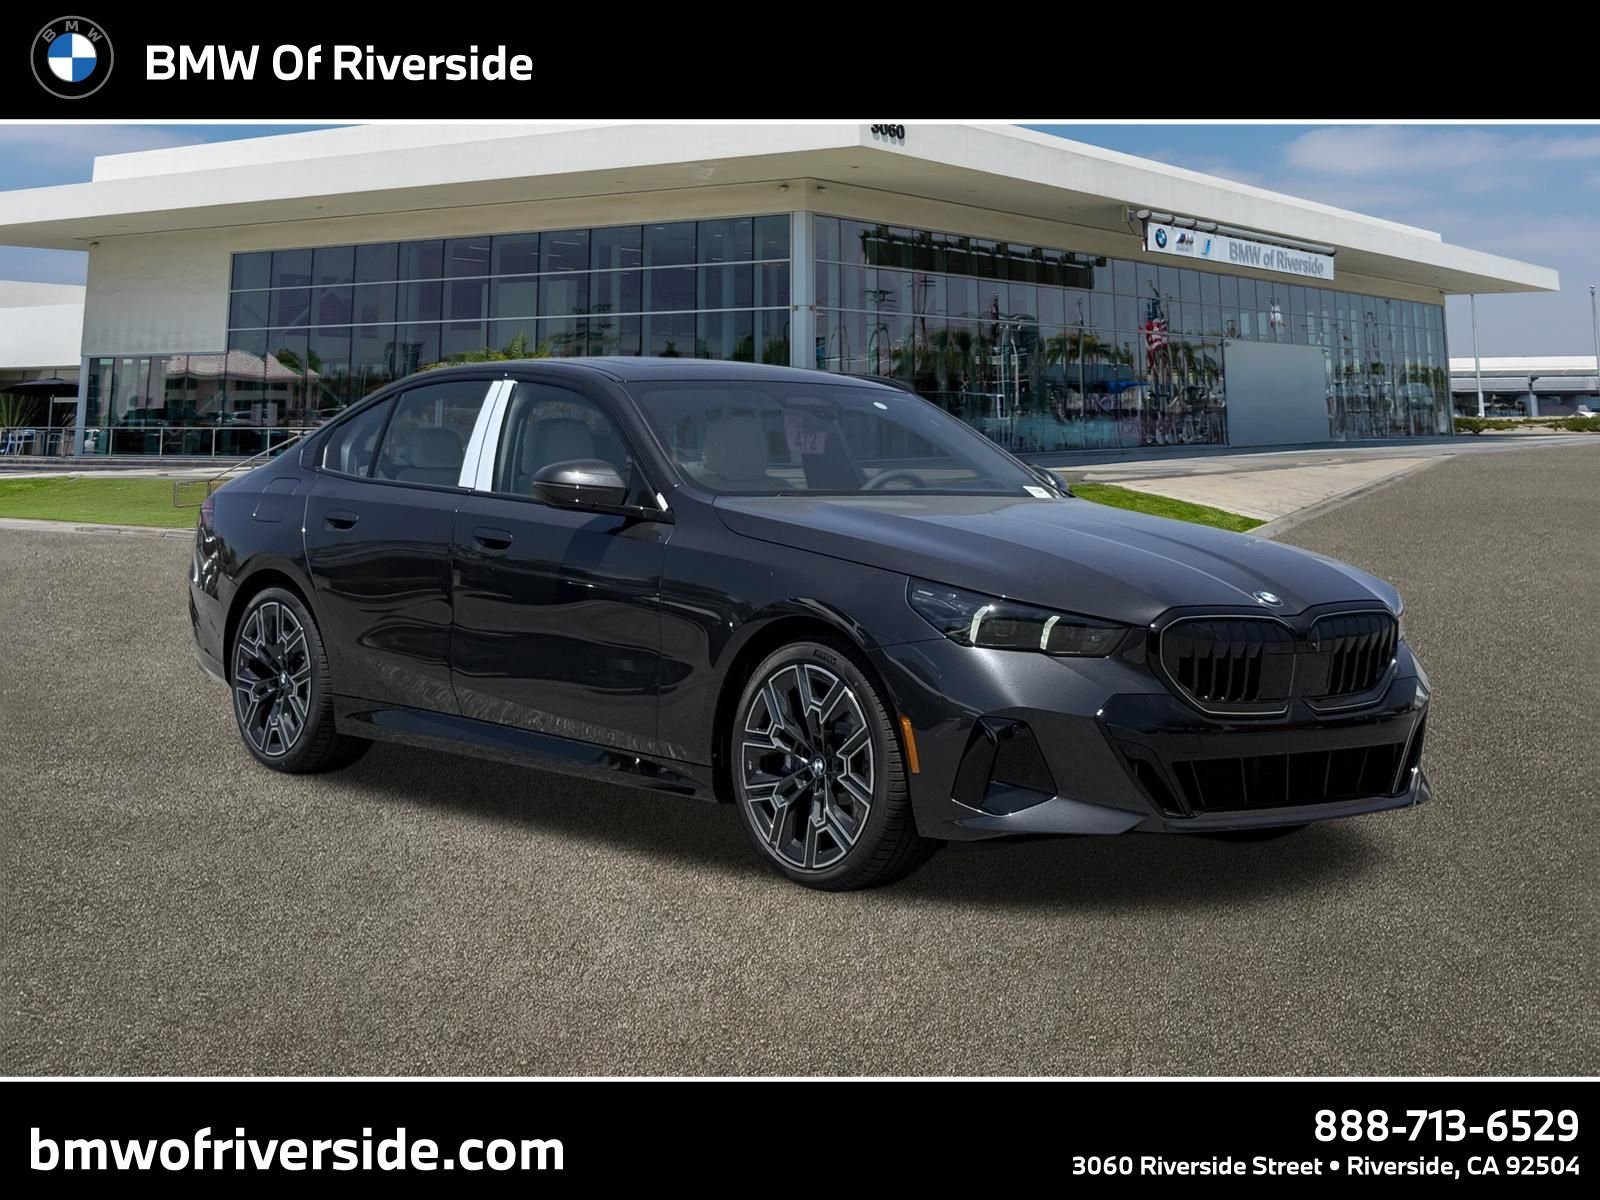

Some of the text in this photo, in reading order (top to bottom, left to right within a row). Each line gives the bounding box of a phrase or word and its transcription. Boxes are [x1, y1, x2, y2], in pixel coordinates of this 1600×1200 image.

[871, 124, 905, 139] 3060
[1229, 241, 1261, 265] BMW
[1263, 249, 1275, 268] of
[1276, 250, 1324, 275] Riverside
